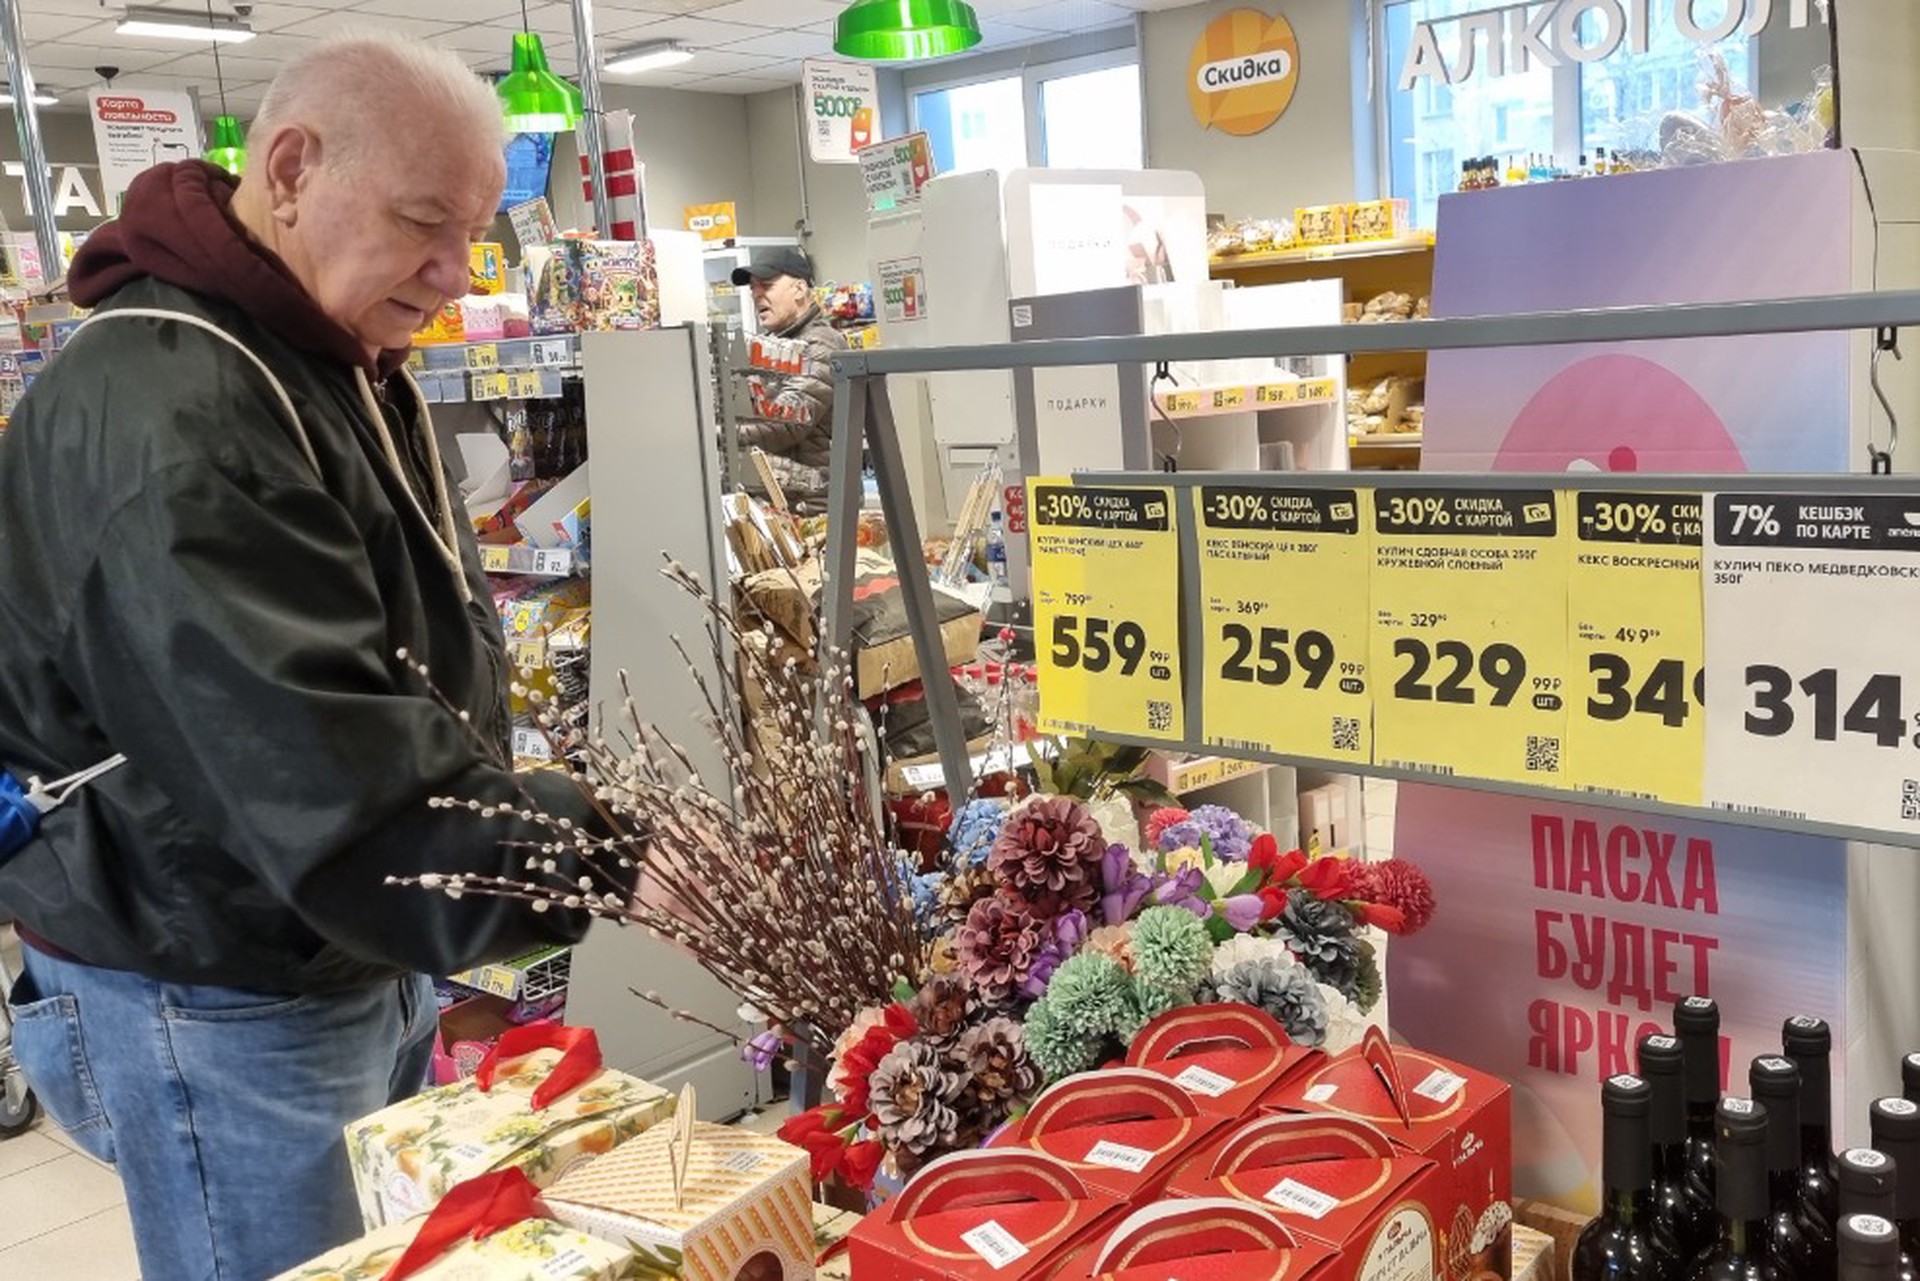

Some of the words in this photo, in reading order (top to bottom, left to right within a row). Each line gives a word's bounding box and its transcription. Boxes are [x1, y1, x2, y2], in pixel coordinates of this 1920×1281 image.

[1397, 0, 1829, 90] АЛКОГОЛ
[1204, 57, 1281, 86] Скидка
[1047, 398, 1106, 411] ПОДАРКИ
[1040, 494, 1092, 519] -30%
[1094, 496, 1130, 508] СКИДКА
[1095, 510, 1102, 520] С
[1103, 509, 1138, 522] КАРТОЙ
[1206, 495, 1268, 521] -30%
[1270, 496, 1313, 509] СКИДКА
[1272, 510, 1279, 522] С
[1280, 509, 1322, 524] КАРТОЙ
[1379, 497, 1450, 526] -30%
[1454, 498, 1503, 512] СКИДКА
[1455, 513, 1463, 526] С
[1466, 511, 1513, 527] КАРТОЙ
[1583, 502, 1666, 533] -30%
[1671, 504, 1702, 519] СКИ
[1672, 522, 1680, 535] С
[1729, 504, 1781, 536] 7%
[1799, 505, 1865, 521] КЕШБЭК
[1796, 525, 1818, 538] ПО
[1822, 525, 1871, 540] КАРТЕ
[1377, 546, 1414, 556] КУЛИЧ
[1416, 547, 1468, 558] СДОБНАЯ
[1470, 549, 1509, 559] ОСОБА
[1377, 557, 1444, 569] КРУЖЕВНОЙ
[1447, 559, 1503, 571] СЛОЕНЫЙ
[1578, 555, 1610, 565] КЕКС
[1612, 555, 1700, 570] ВОСКРЕСНЫЙ
[1713, 560, 1762, 572] КУЛИЧ
[1766, 561, 1804, 573] ПЕКО
[1713, 573, 1743, 584] 350Г
[1052, 615, 1147, 676] 559
[1220, 623, 1335, 690] 259
[1394, 638, 1527, 707] 229
[1744, 664, 1907, 748] 314
[1531, 813, 1719, 915] ПАСХА
[1535, 909, 1719, 1012] БУДЕТ
[1527, 998, 1731, 1091] ЯРК
